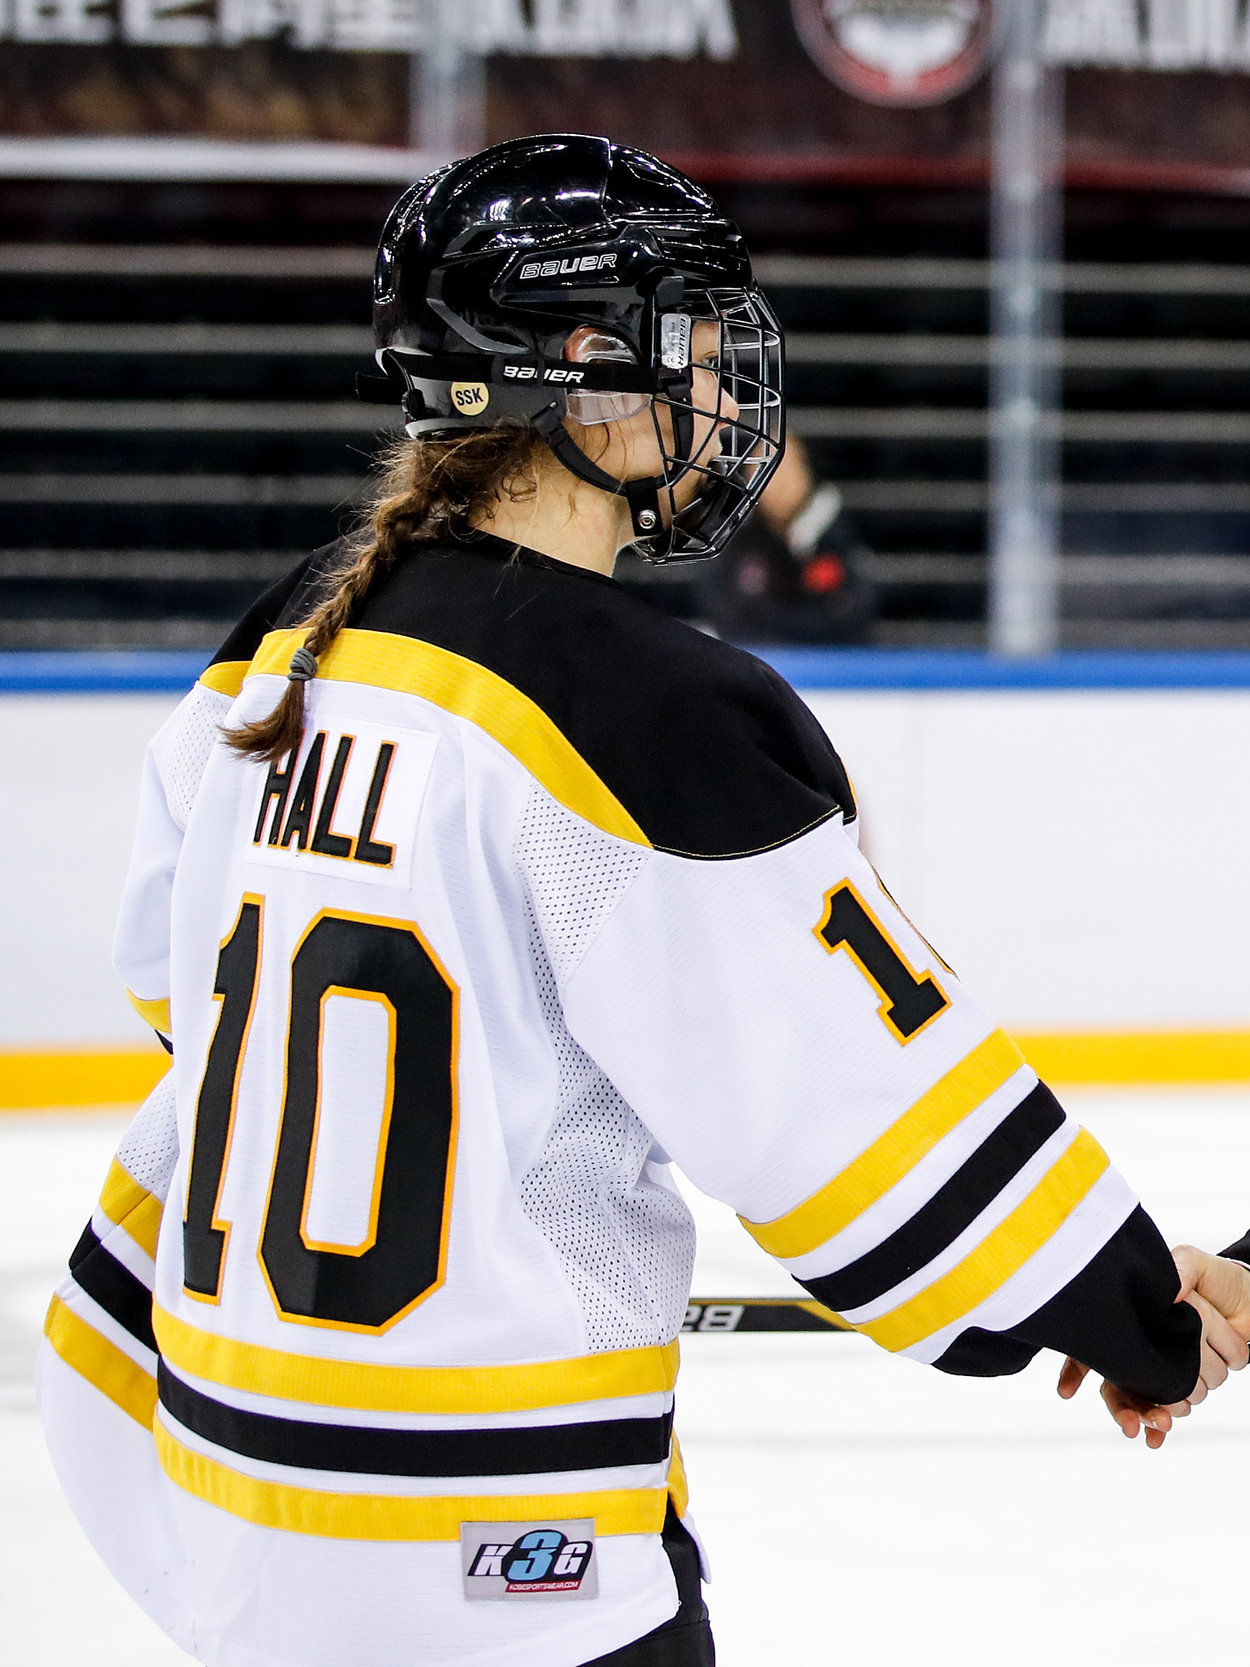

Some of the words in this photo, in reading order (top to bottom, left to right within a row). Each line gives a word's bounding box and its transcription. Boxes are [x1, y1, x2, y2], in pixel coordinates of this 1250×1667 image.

[519, 252, 618, 281] BAUER
[677, 315, 688, 367] BAUER
[455, 386, 485, 407] SSK
[252, 728, 399, 868] HALL
[182, 891, 461, 1337] 10
[468, 1529, 593, 1583] K3G
